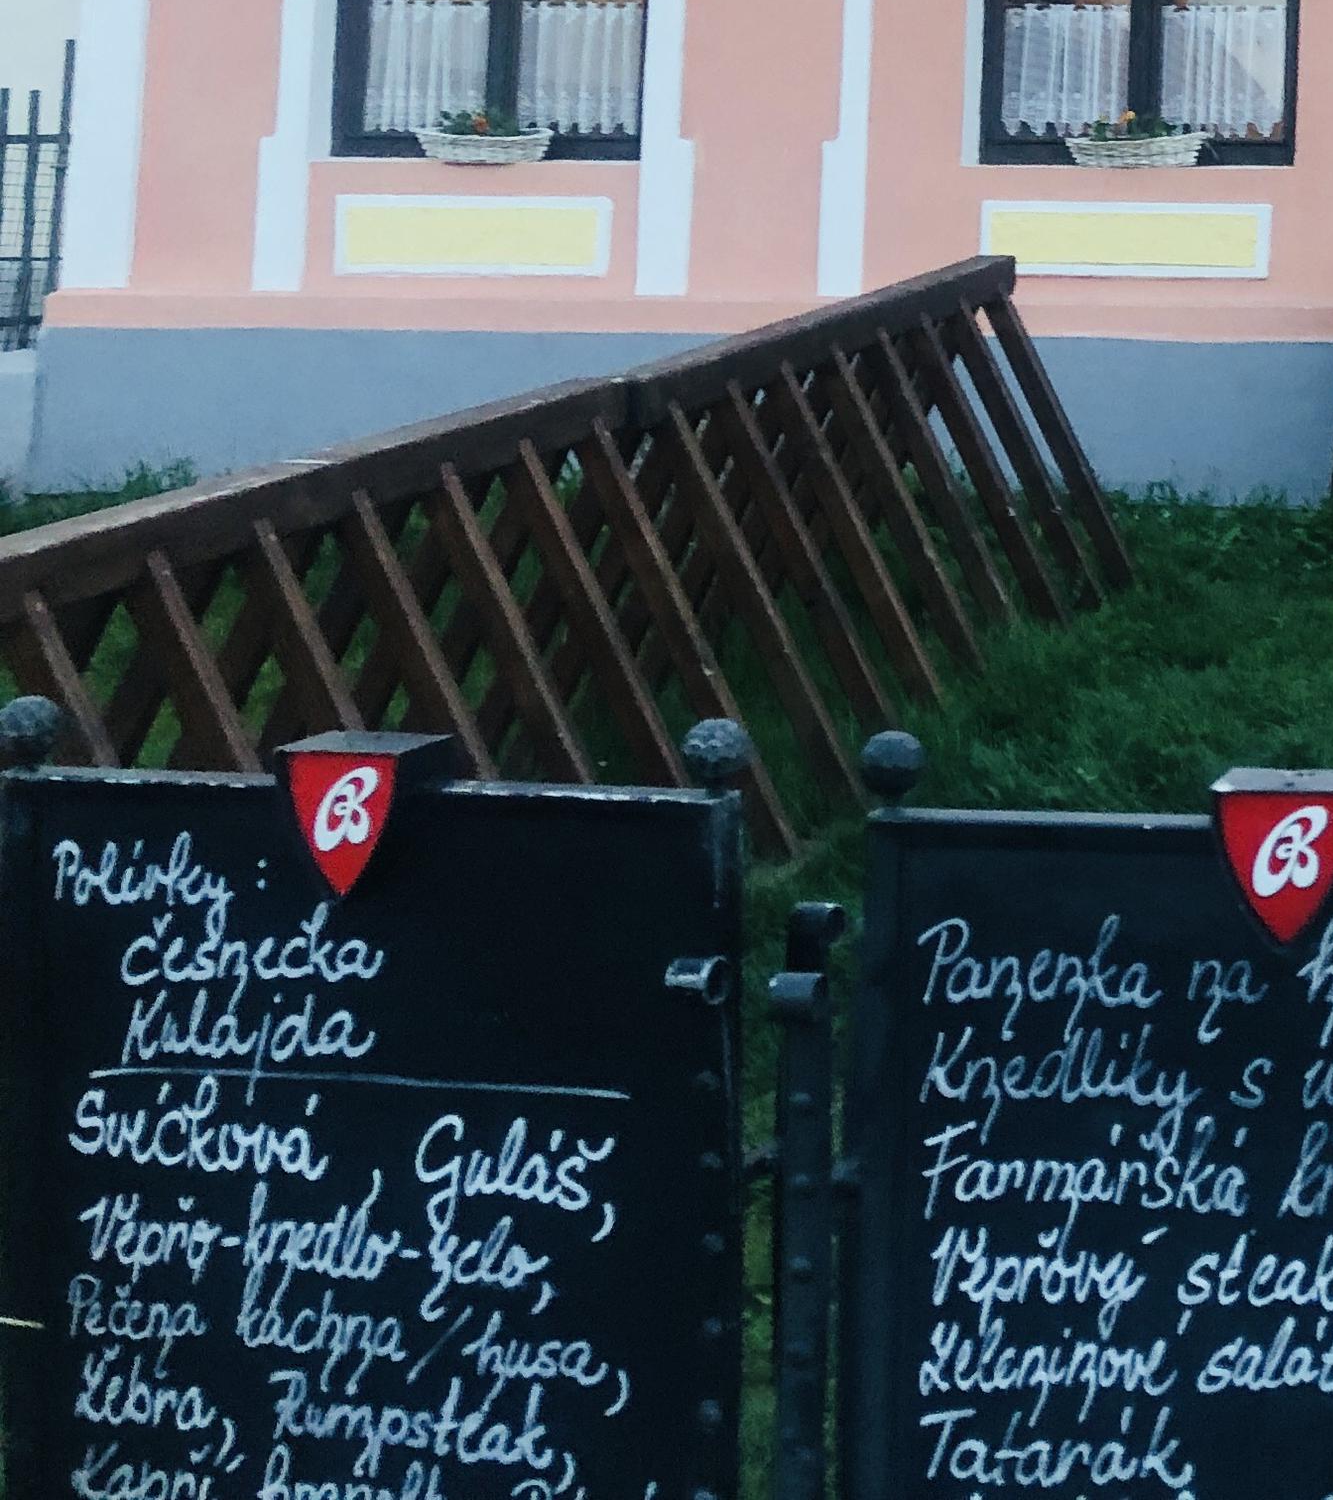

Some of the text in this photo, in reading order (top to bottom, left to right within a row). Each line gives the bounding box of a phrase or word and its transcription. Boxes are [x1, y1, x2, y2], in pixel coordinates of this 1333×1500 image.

[916, 912, 1163, 1043] Panenka
[1186, 958, 1270, 1045] na
[121, 988, 377, 1106] Kulajda
[1229, 1056, 1275, 1109] s
[235, 1265, 407, 1394] kachna
